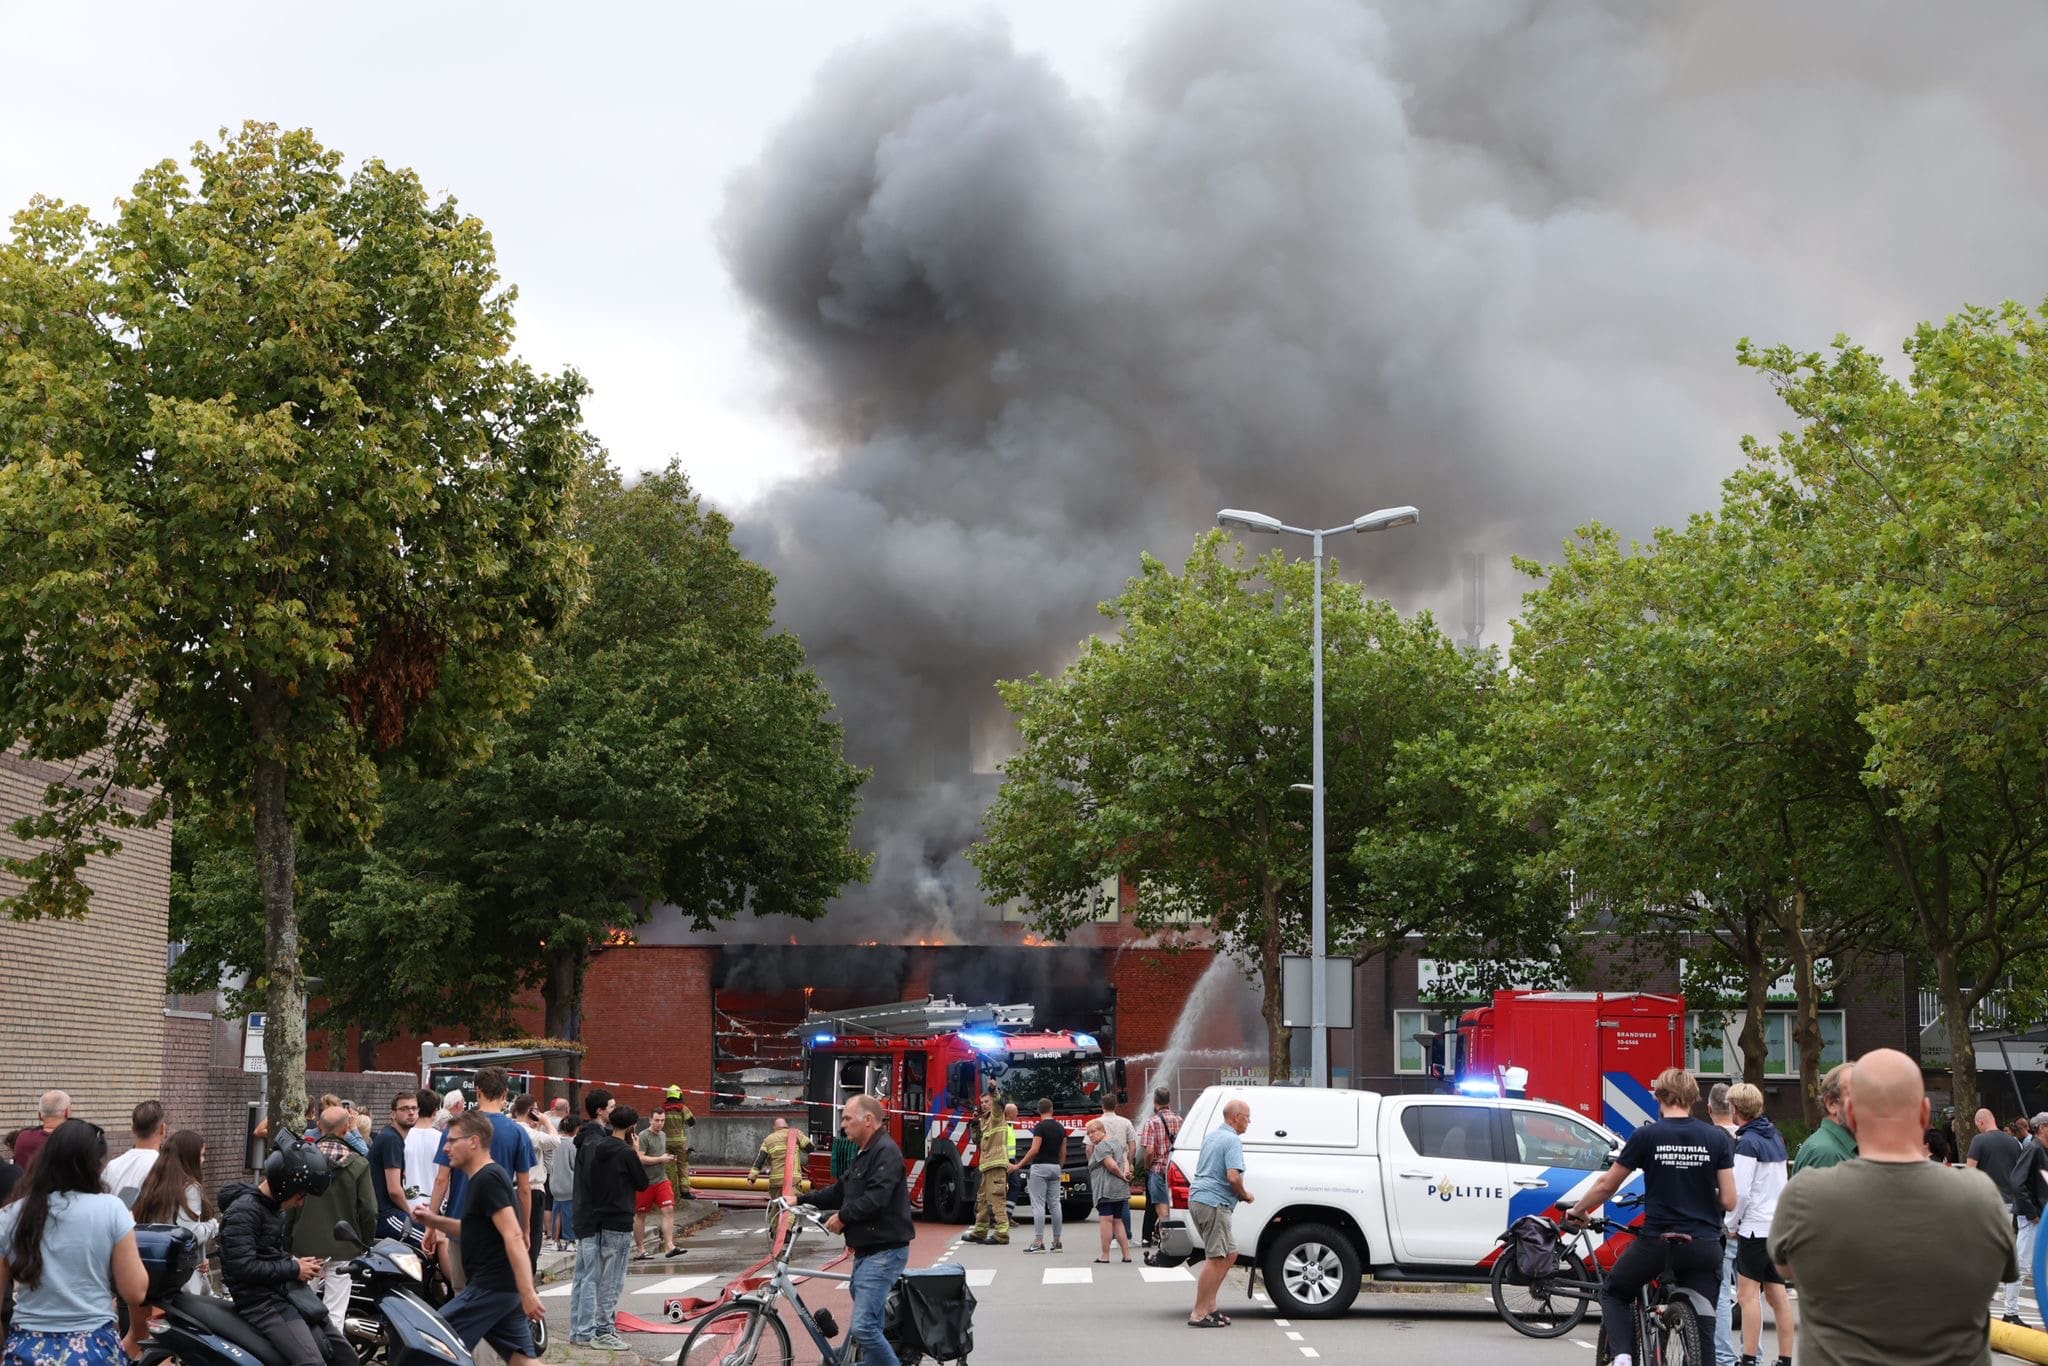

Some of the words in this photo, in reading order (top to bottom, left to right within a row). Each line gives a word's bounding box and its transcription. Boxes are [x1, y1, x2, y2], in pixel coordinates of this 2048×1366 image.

[1033, 1051, 1062, 1059] Koedijk
[1020, 1119, 1083, 1130] BRWEER
[1656, 1145, 1709, 1153] INDUSTRIAL
[1654, 1153, 1711, 1162] FIREFIGHTER
[1428, 1184, 1503, 1202] POLITIE
